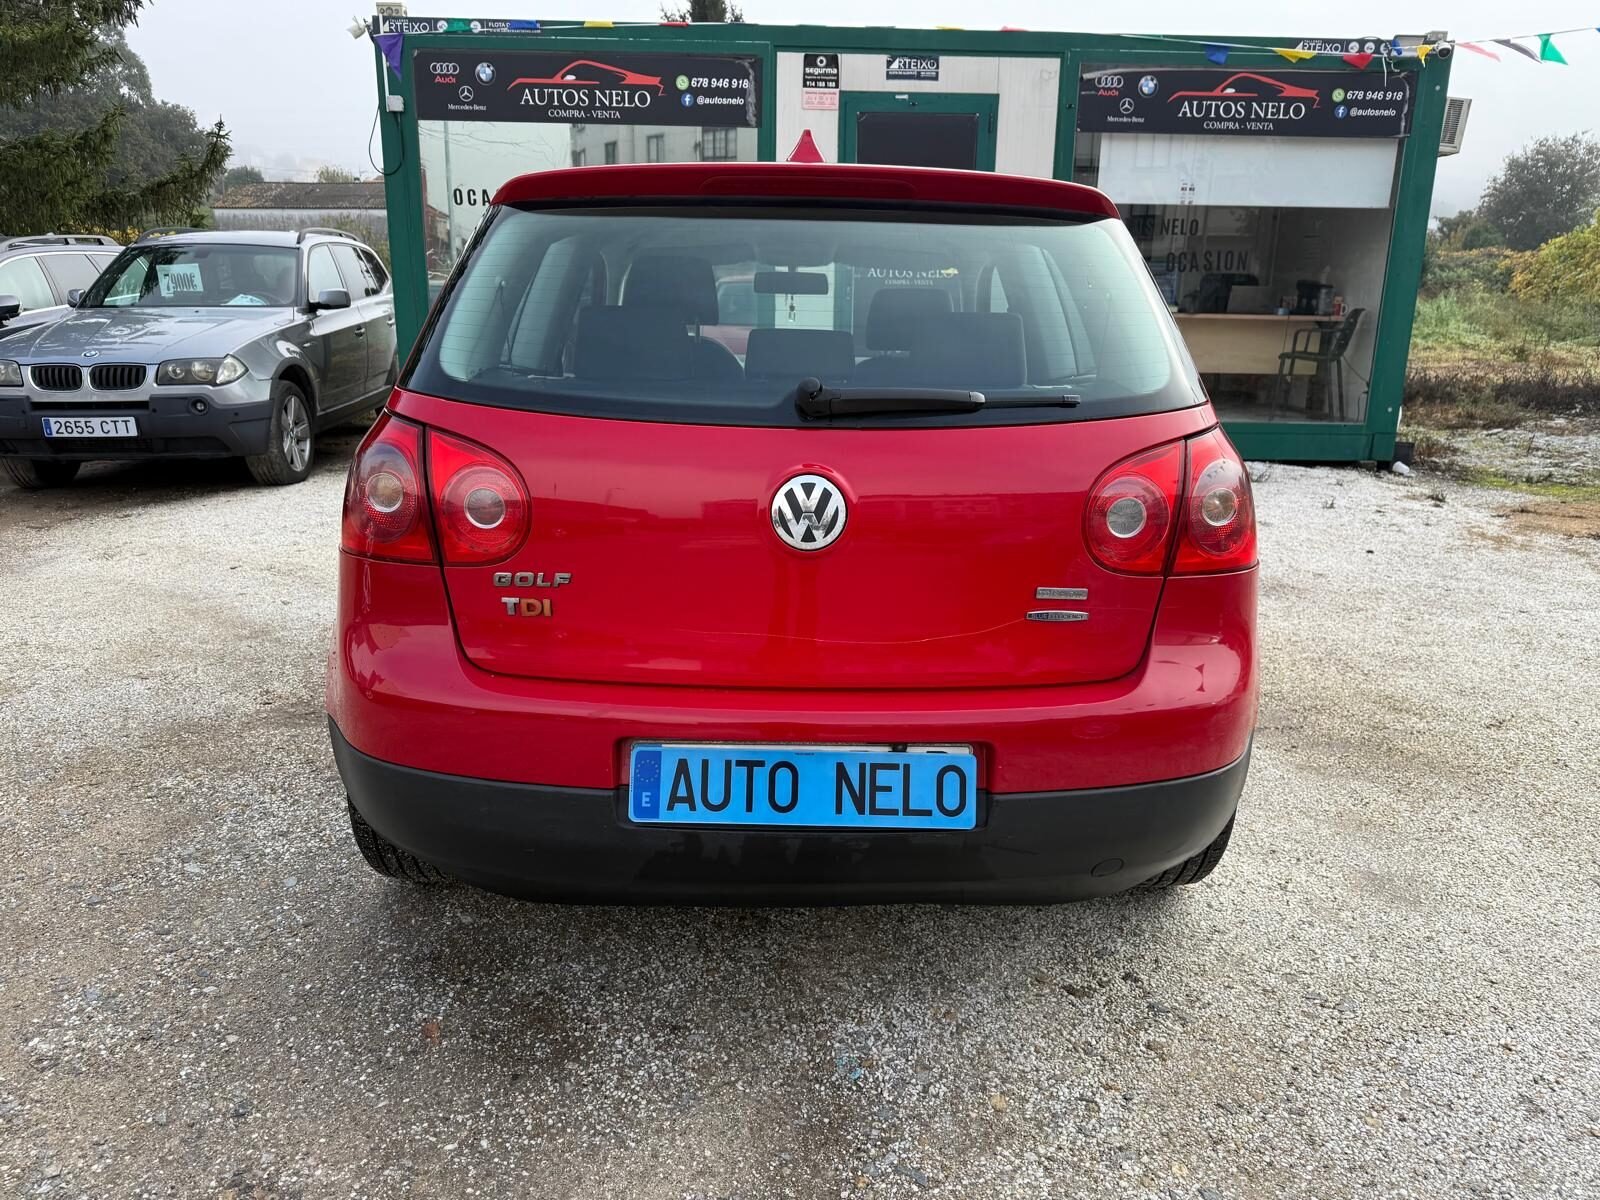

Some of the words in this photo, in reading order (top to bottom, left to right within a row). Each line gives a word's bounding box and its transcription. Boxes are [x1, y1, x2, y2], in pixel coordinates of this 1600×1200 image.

[805, 67, 838, 75] segurma
[434, 75, 456, 84] Audi
[691, 77, 709, 88] 678
[710, 77, 730, 88] 946
[731, 78, 750, 89] 918
[520, 88, 589, 106] AUTOS
[594, 89, 651, 107] NELO
[697, 95, 745, 105] @autosnelo
[1346, 90, 1364, 99] 678
[1365, 91, 1384, 100] 946
[1386, 91, 1404, 101] 918
[447, 103, 487, 111] Mercedes-Benz
[1177, 100, 1246, 118] AUTOS
[1250, 102, 1306, 120] NELO
[1350, 107, 1396, 117] @autosnelo
[548, 109, 586, 118] COMPRA
[591, 110, 621, 119] VENTA
[1107, 115, 1145, 123] Mercedes-Benz
[1203, 120, 1240, 130] COMPRA
[1245, 121, 1274, 131] VENTA
[1160, 218, 1199, 236] NELO
[1166, 250, 1248, 272] OCASION
[163, 272, 198, 292] 7900€
[54, 420, 95, 434] 2655
[100, 419, 131, 434] CTT
[493, 572, 571, 587] GOLF
[501, 597, 552, 617] TDI
[666, 758, 799, 814] AUTO
[834, 761, 967, 818] NELO
[641, 791, 651, 807] E
